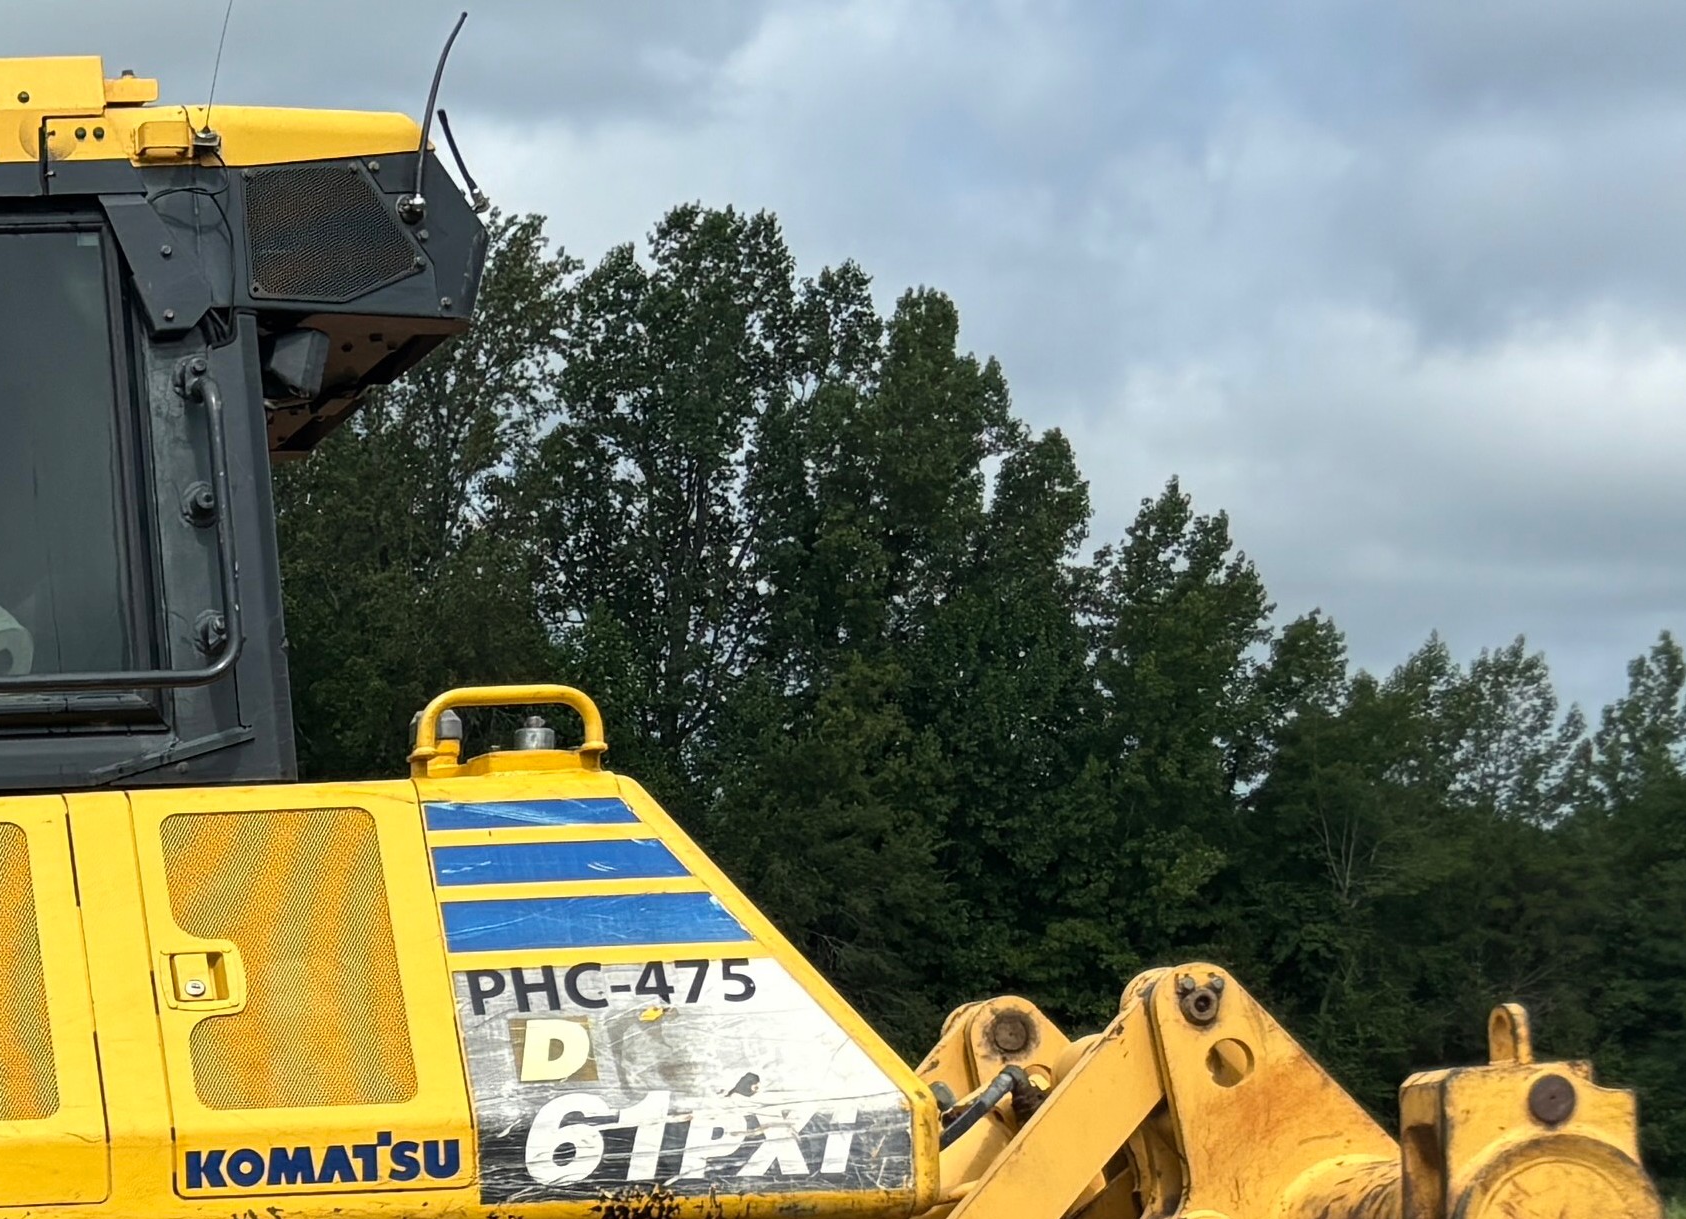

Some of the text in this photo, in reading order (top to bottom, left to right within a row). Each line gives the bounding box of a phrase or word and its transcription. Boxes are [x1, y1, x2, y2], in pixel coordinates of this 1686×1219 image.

[466, 958, 756, 1015] PHC-475
[521, 1019, 590, 1082] D
[185, 1131, 460, 1189] KOMATSU
